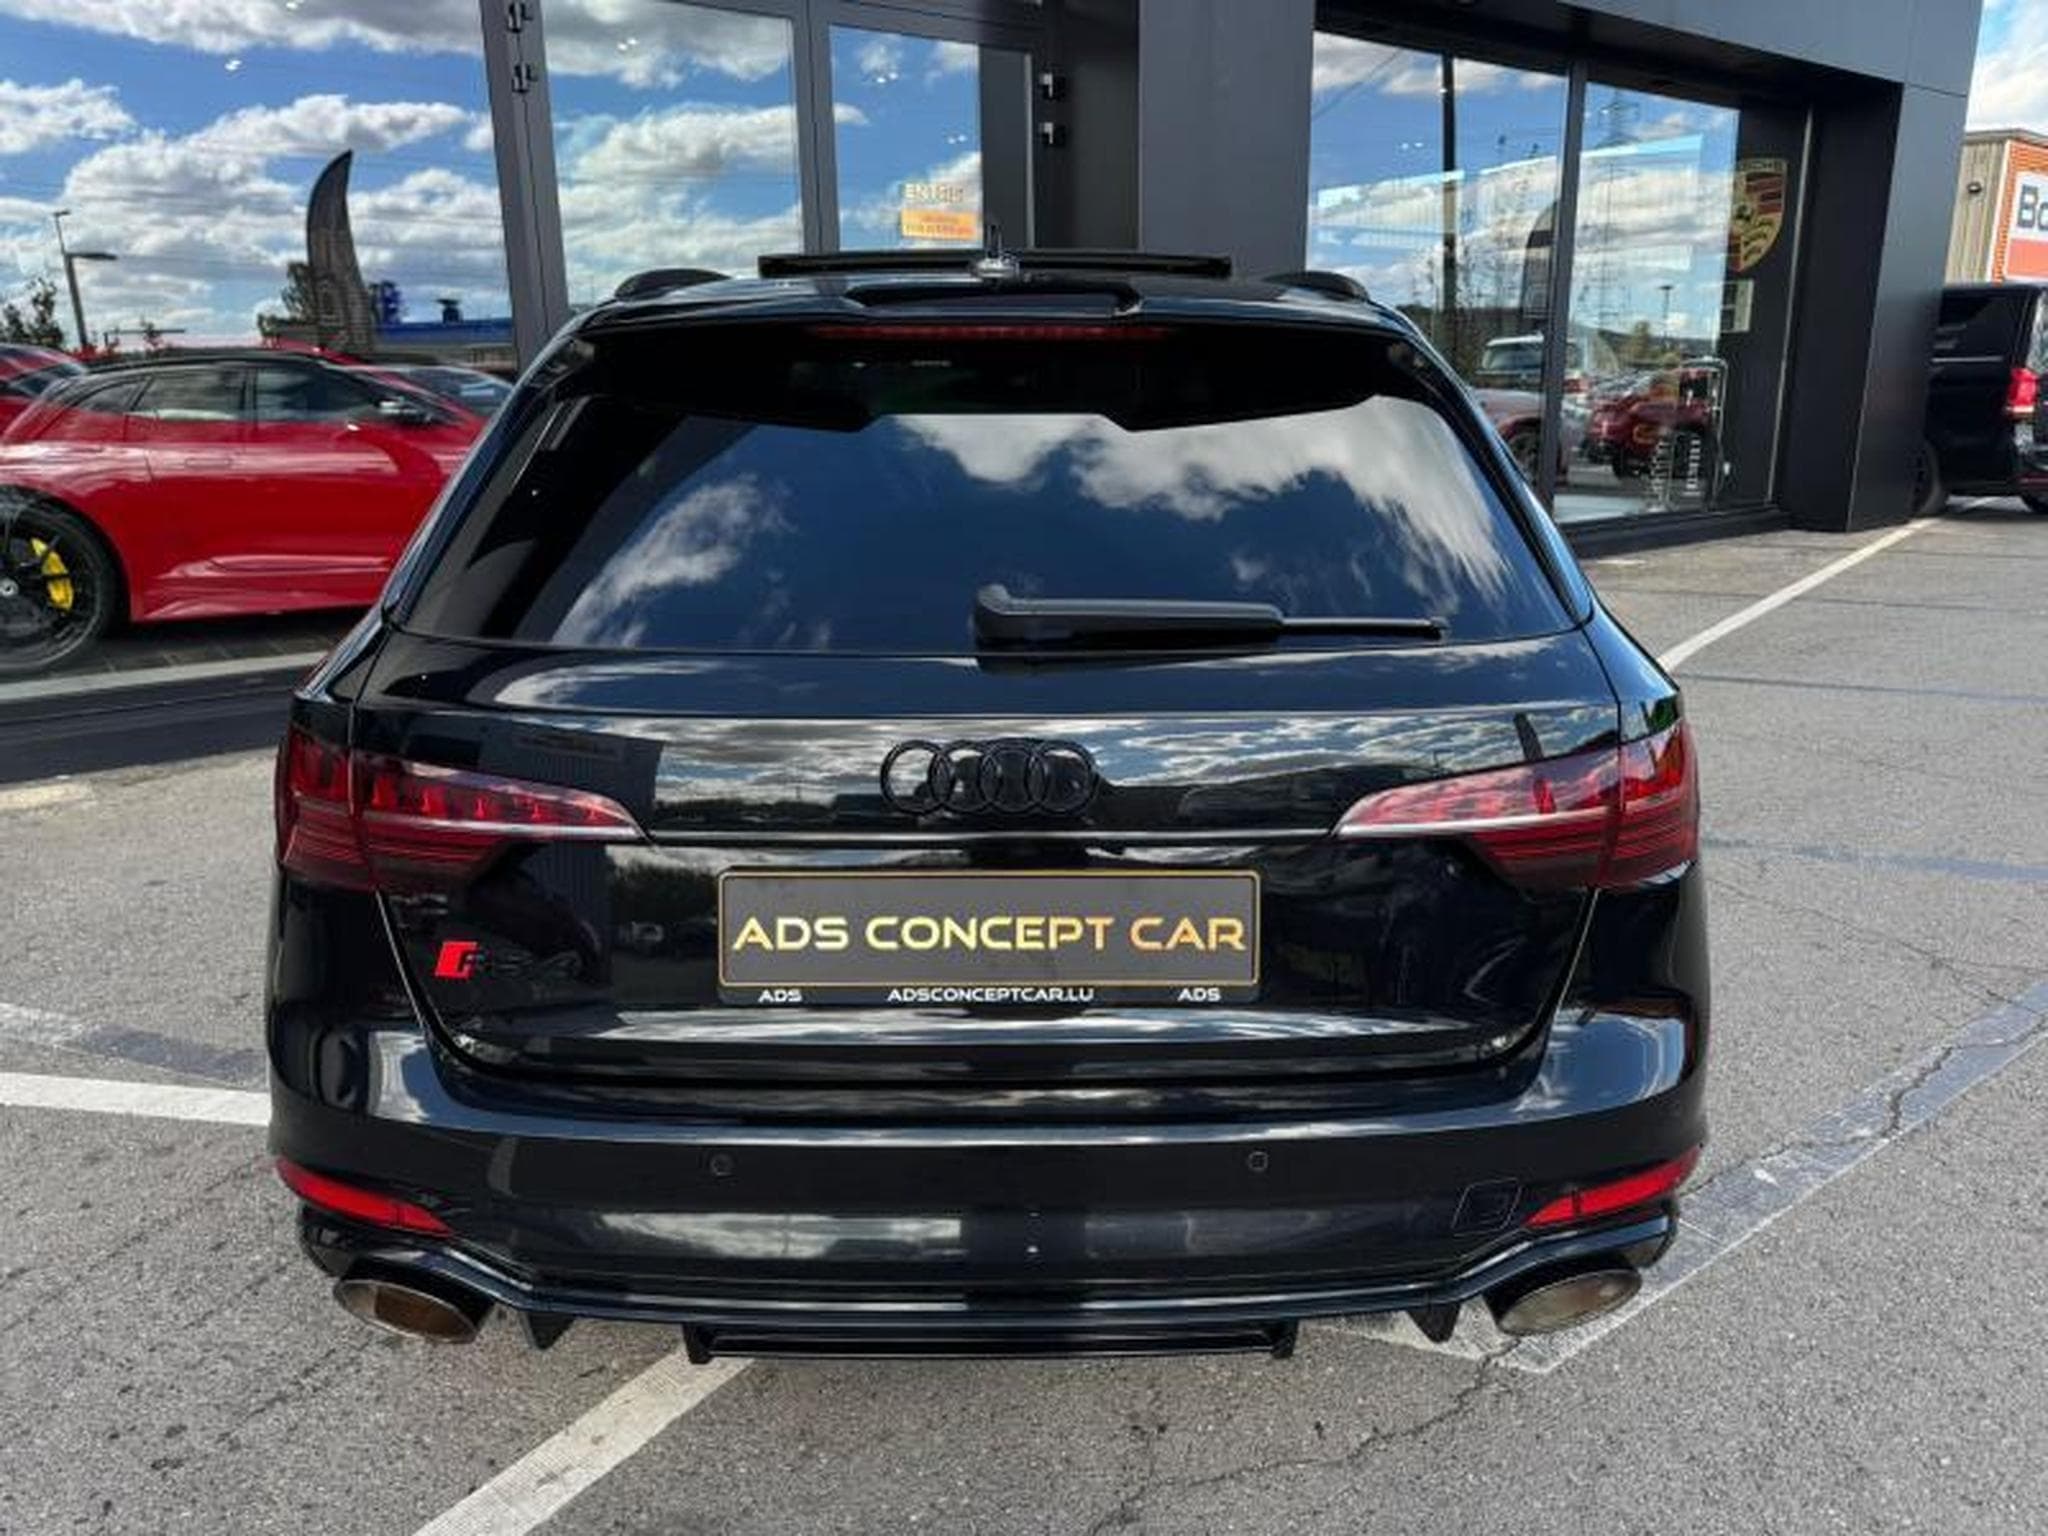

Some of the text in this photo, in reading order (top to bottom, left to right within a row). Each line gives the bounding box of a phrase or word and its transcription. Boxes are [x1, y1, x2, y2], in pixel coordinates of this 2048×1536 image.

[732, 916, 1247, 952] ADS CONCEPT CAR
[758, 988, 802, 1003] ADS
[886, 988, 1095, 1003] ADSCONCEPTCAR.LU
[1177, 988, 1221, 1003] ADS
